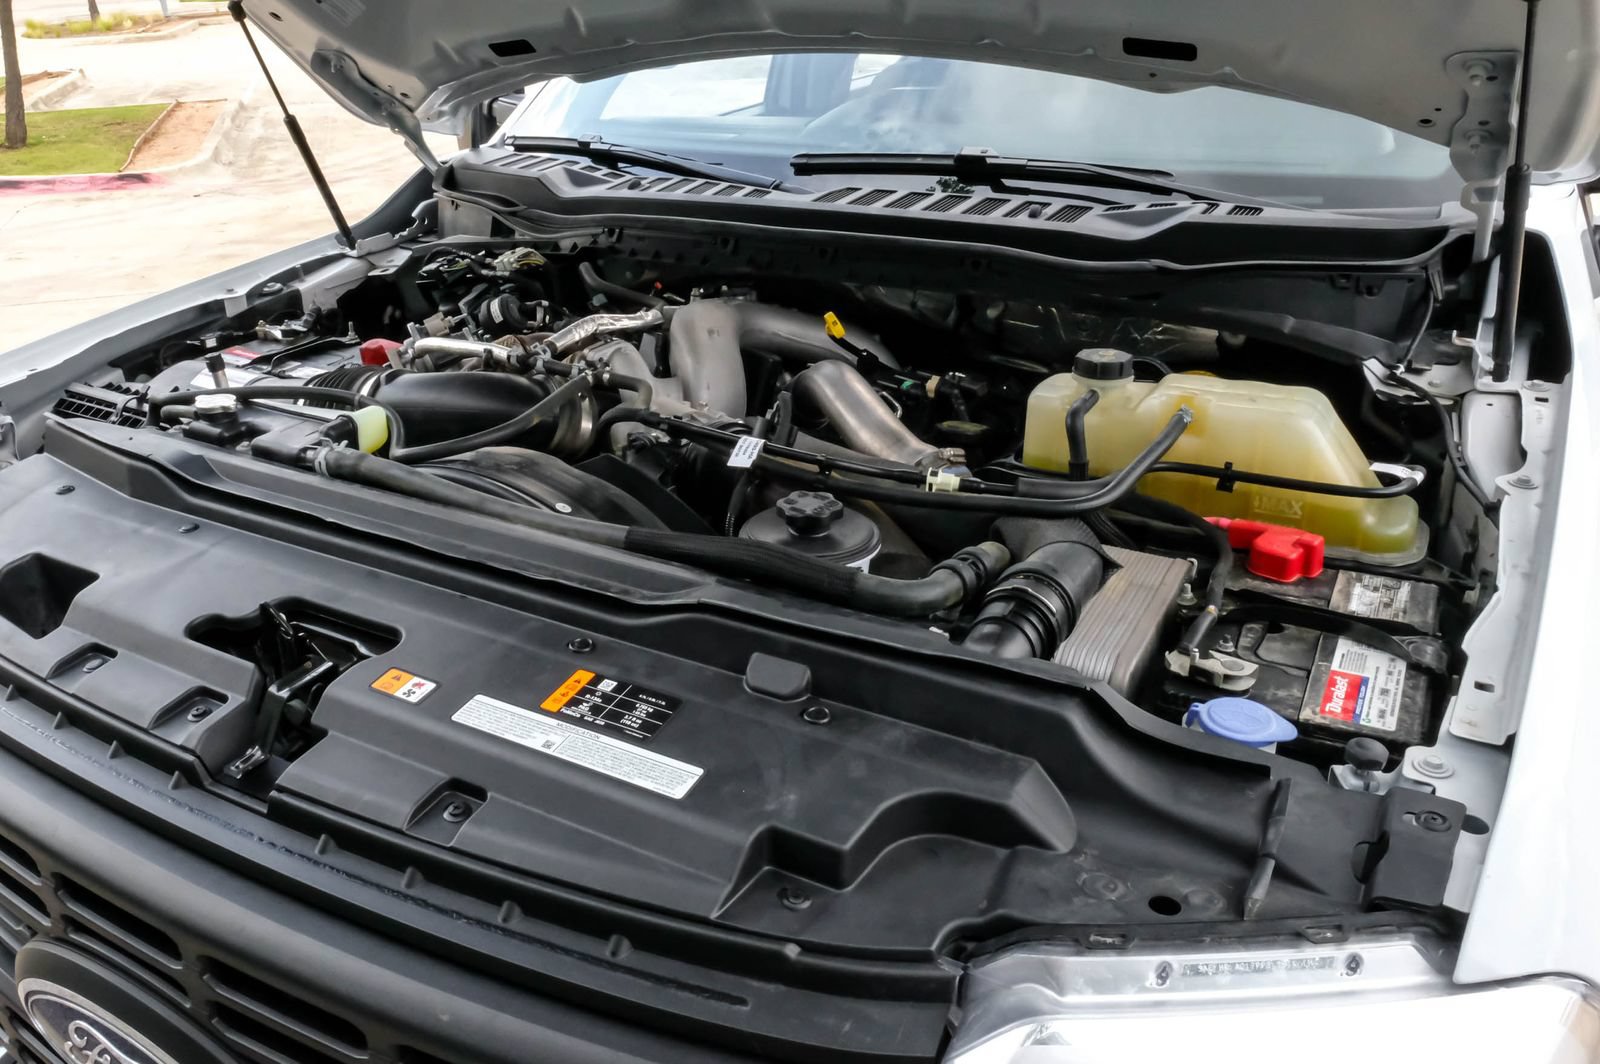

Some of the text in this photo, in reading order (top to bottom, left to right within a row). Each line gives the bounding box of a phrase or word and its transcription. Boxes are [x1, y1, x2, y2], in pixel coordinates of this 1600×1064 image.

[1262, 496, 1303, 516] MAX
[1325, 675, 1349, 713] Duralast
[557, 722, 601, 740] MODIFICATION
